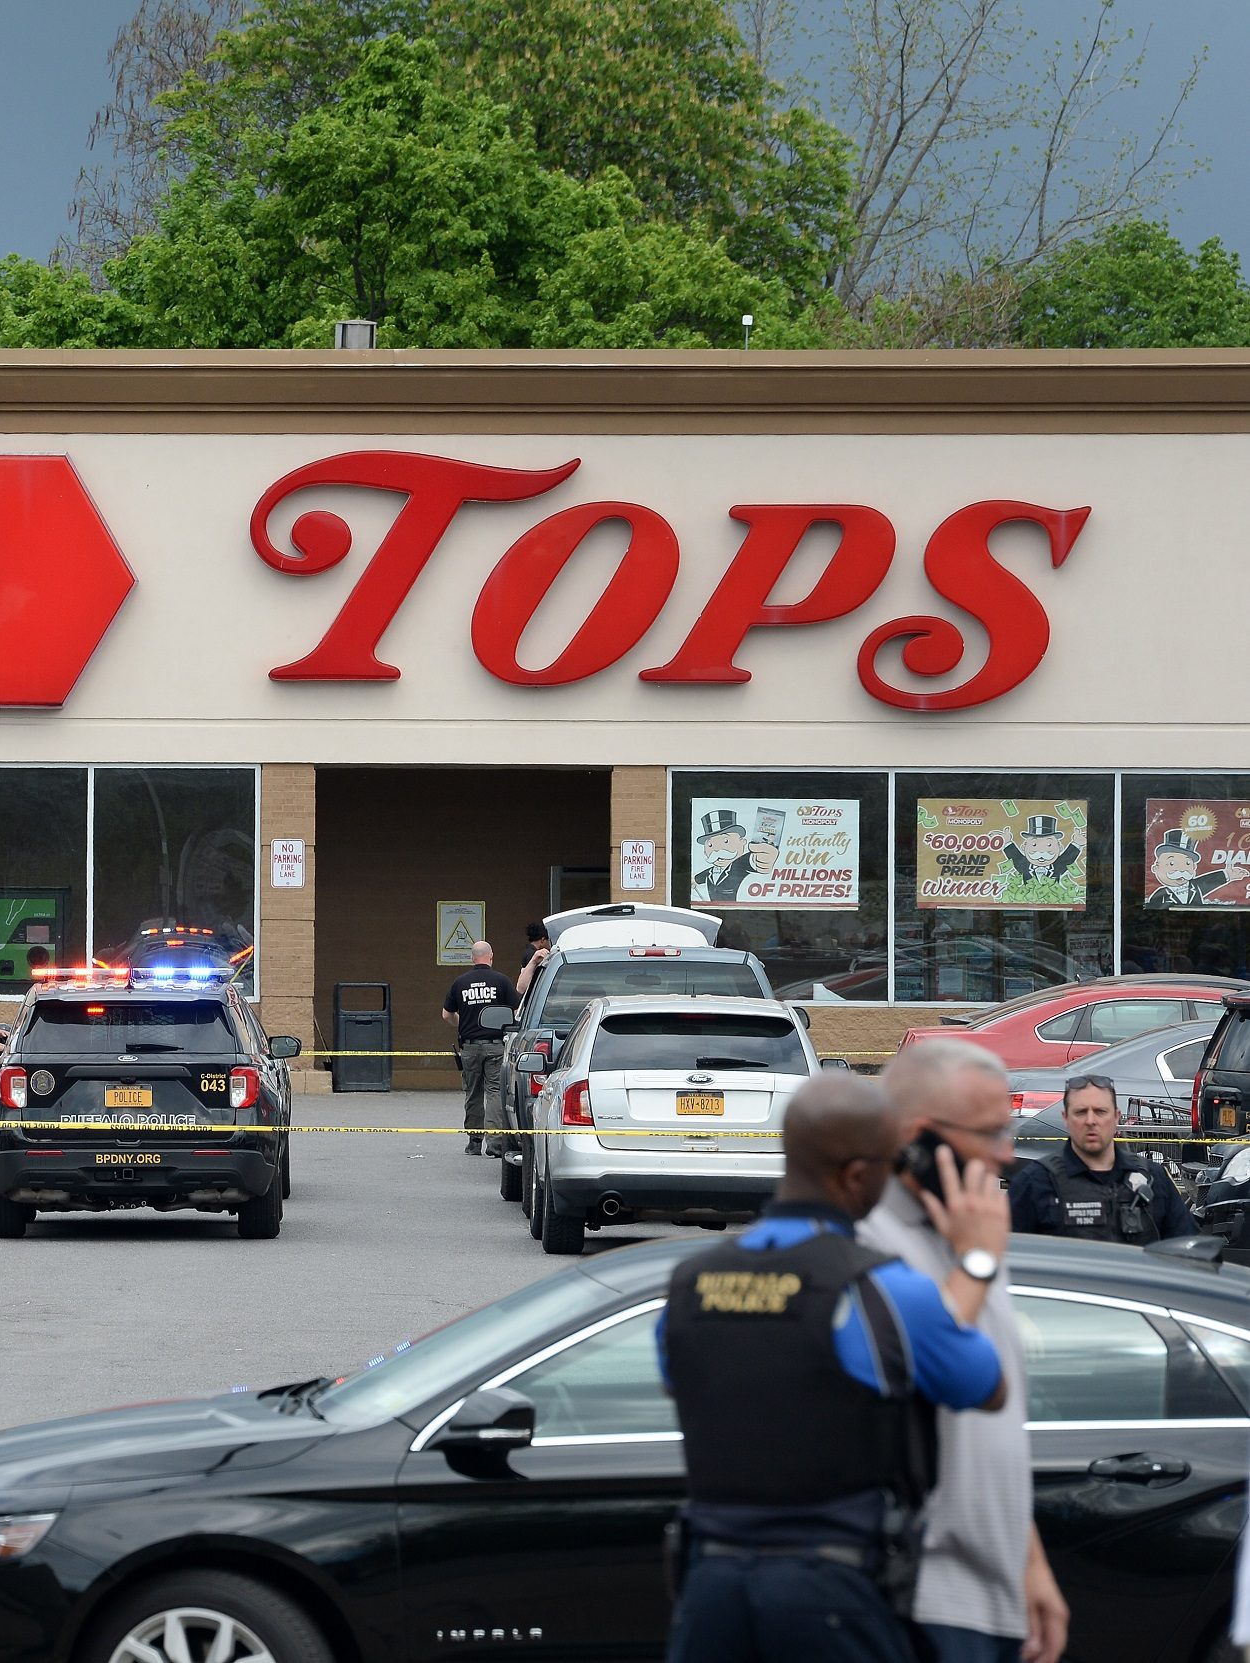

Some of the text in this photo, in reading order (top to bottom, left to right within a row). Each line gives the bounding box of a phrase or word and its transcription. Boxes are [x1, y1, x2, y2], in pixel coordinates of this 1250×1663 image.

[1188, 814, 1208, 826] 60
[281, 844, 294, 853] NO
[786, 831, 852, 855] instantly
[923, 832, 1005, 853] $60,000
[631, 845, 644, 854] NO
[274, 855, 302, 864] PARKING
[624, 856, 652, 865] PARKING
[936, 854, 990, 865] GRAND
[771, 868, 853, 881] MILLIONS
[940, 866, 986, 876] PRIZE
[747, 883, 853, 898] OF PRIZES!
[461, 986, 497, 1002] POLICE
[200, 1080, 226, 1092] 043
[114, 1091, 143, 1103] POLICE
[95, 1154, 161, 1164] BPDNY.ORG
